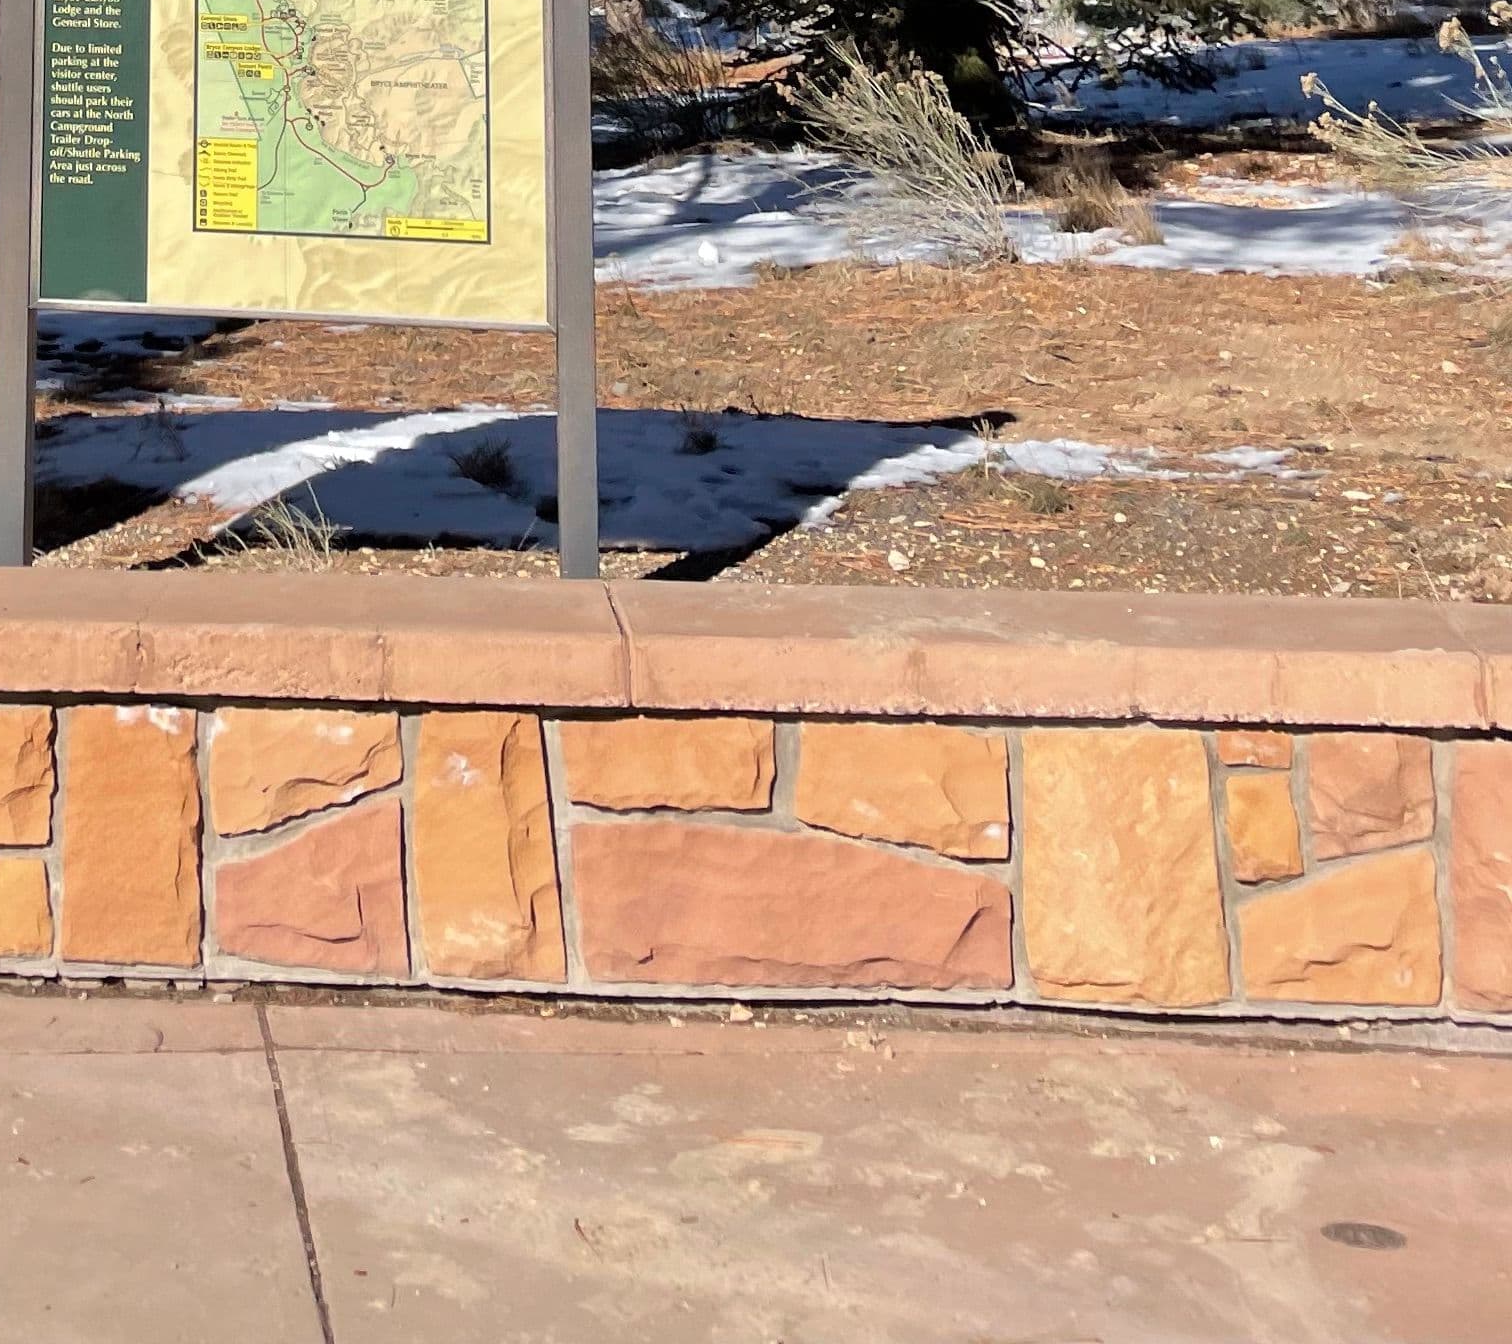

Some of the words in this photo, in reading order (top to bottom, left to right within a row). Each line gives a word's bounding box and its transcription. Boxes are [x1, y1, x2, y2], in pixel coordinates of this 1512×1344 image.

[53, 4, 81, 17] Lodge
[84, 5, 102, 15] and
[106, 5, 121, 15] the
[52, 17, 90, 27] General
[94, 18, 121, 28] Store.
[52, 43, 72, 53] Due
[76, 44, 85, 53] to
[88, 43, 122, 54] limited
[52, 56, 88, 69] parking
[90, 58, 100, 66] at
[104, 57, 119, 67] the
[52, 69, 81, 78] visitor
[84, 71, 117, 82] center,
[51, 81, 83, 92] shuttle
[87, 85, 111, 93] users
[51, 94, 83, 105] should
[86, 96, 107, 107] park
[111, 96, 133, 107] their
[51, 110, 70, 118] cars
[73, 109, 83, 118] at
[86, 109, 101, 118] the
[105, 109, 134, 120] North
[51, 121, 113, 134] Campground
[51, 133, 80, 144] Trailer
[84, 135, 113, 148] Drop-
[50, 147, 100, 158] off/Shuttle
[104, 148, 141, 163] Parking
[50, 160, 72, 170] Area
[76, 161, 93, 173] just
[96, 164, 126, 172] across
[50, 173, 65, 183] the
[68, 174, 93, 184] road.
